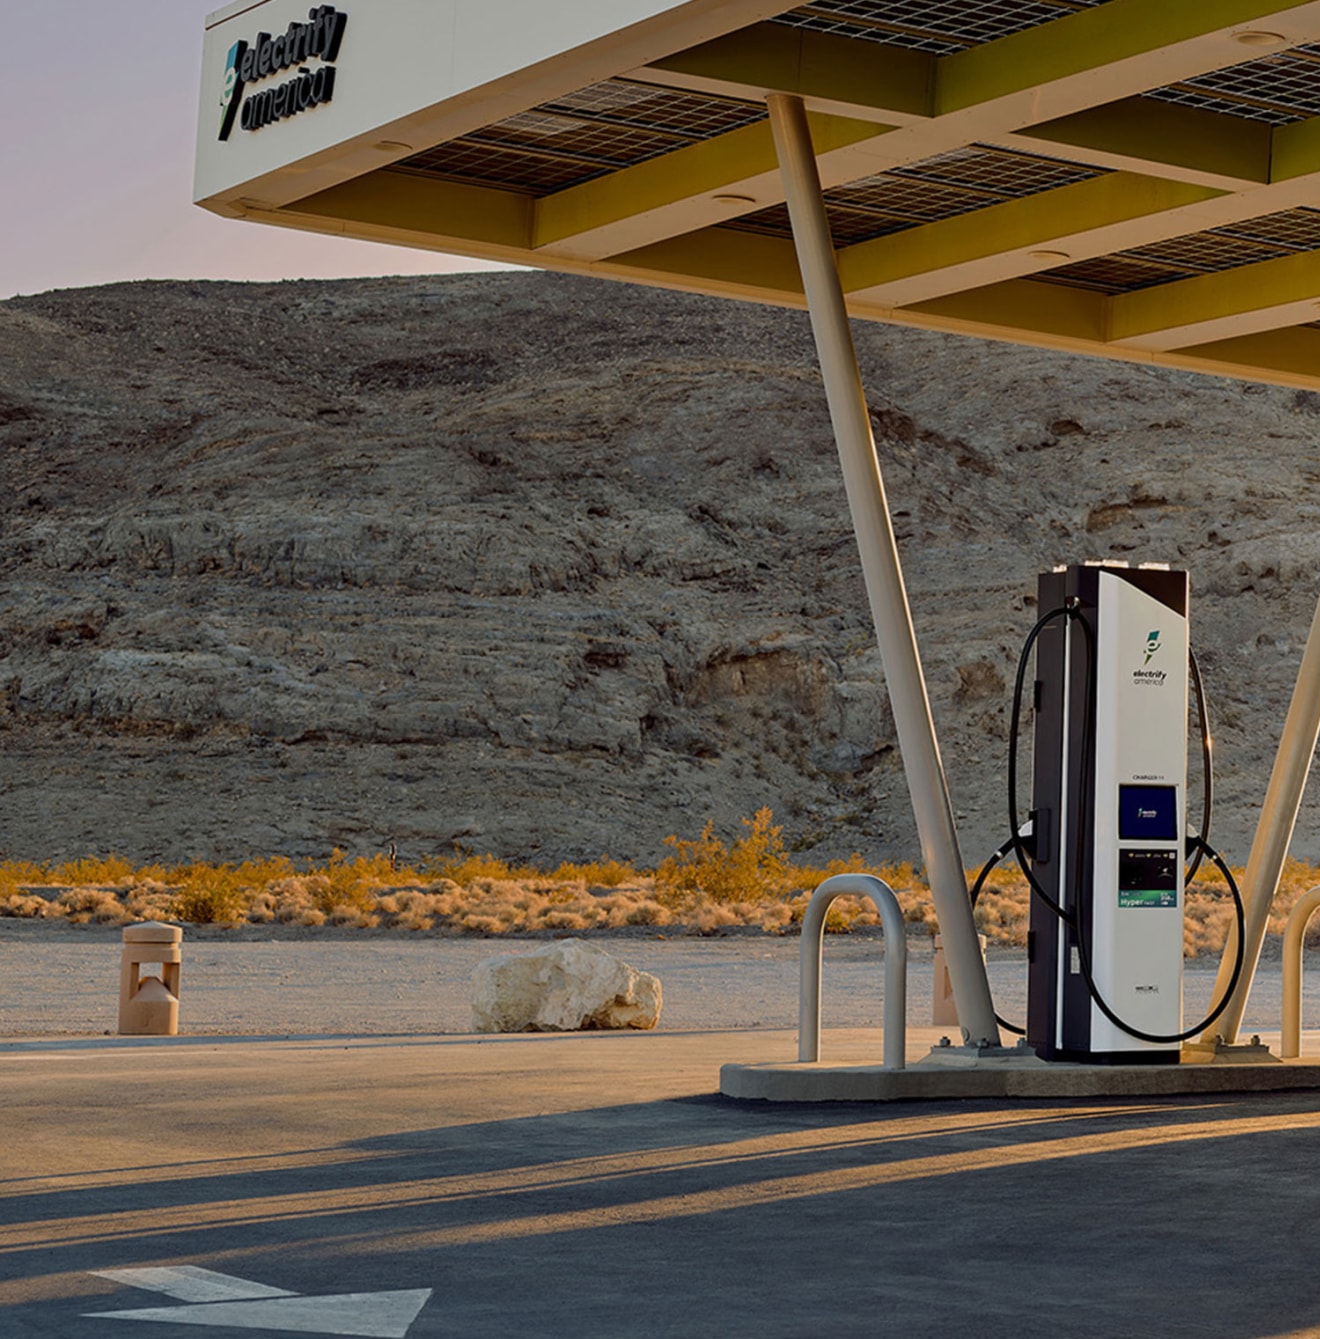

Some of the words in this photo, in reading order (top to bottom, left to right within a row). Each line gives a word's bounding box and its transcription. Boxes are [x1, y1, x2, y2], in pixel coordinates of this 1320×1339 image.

[240, 5, 347, 82] electrify
[240, 66, 336, 130] america
[1133, 669, 1167, 681] electrify
[1133, 678, 1164, 687] america
[1120, 899, 1144, 907] Hyper
